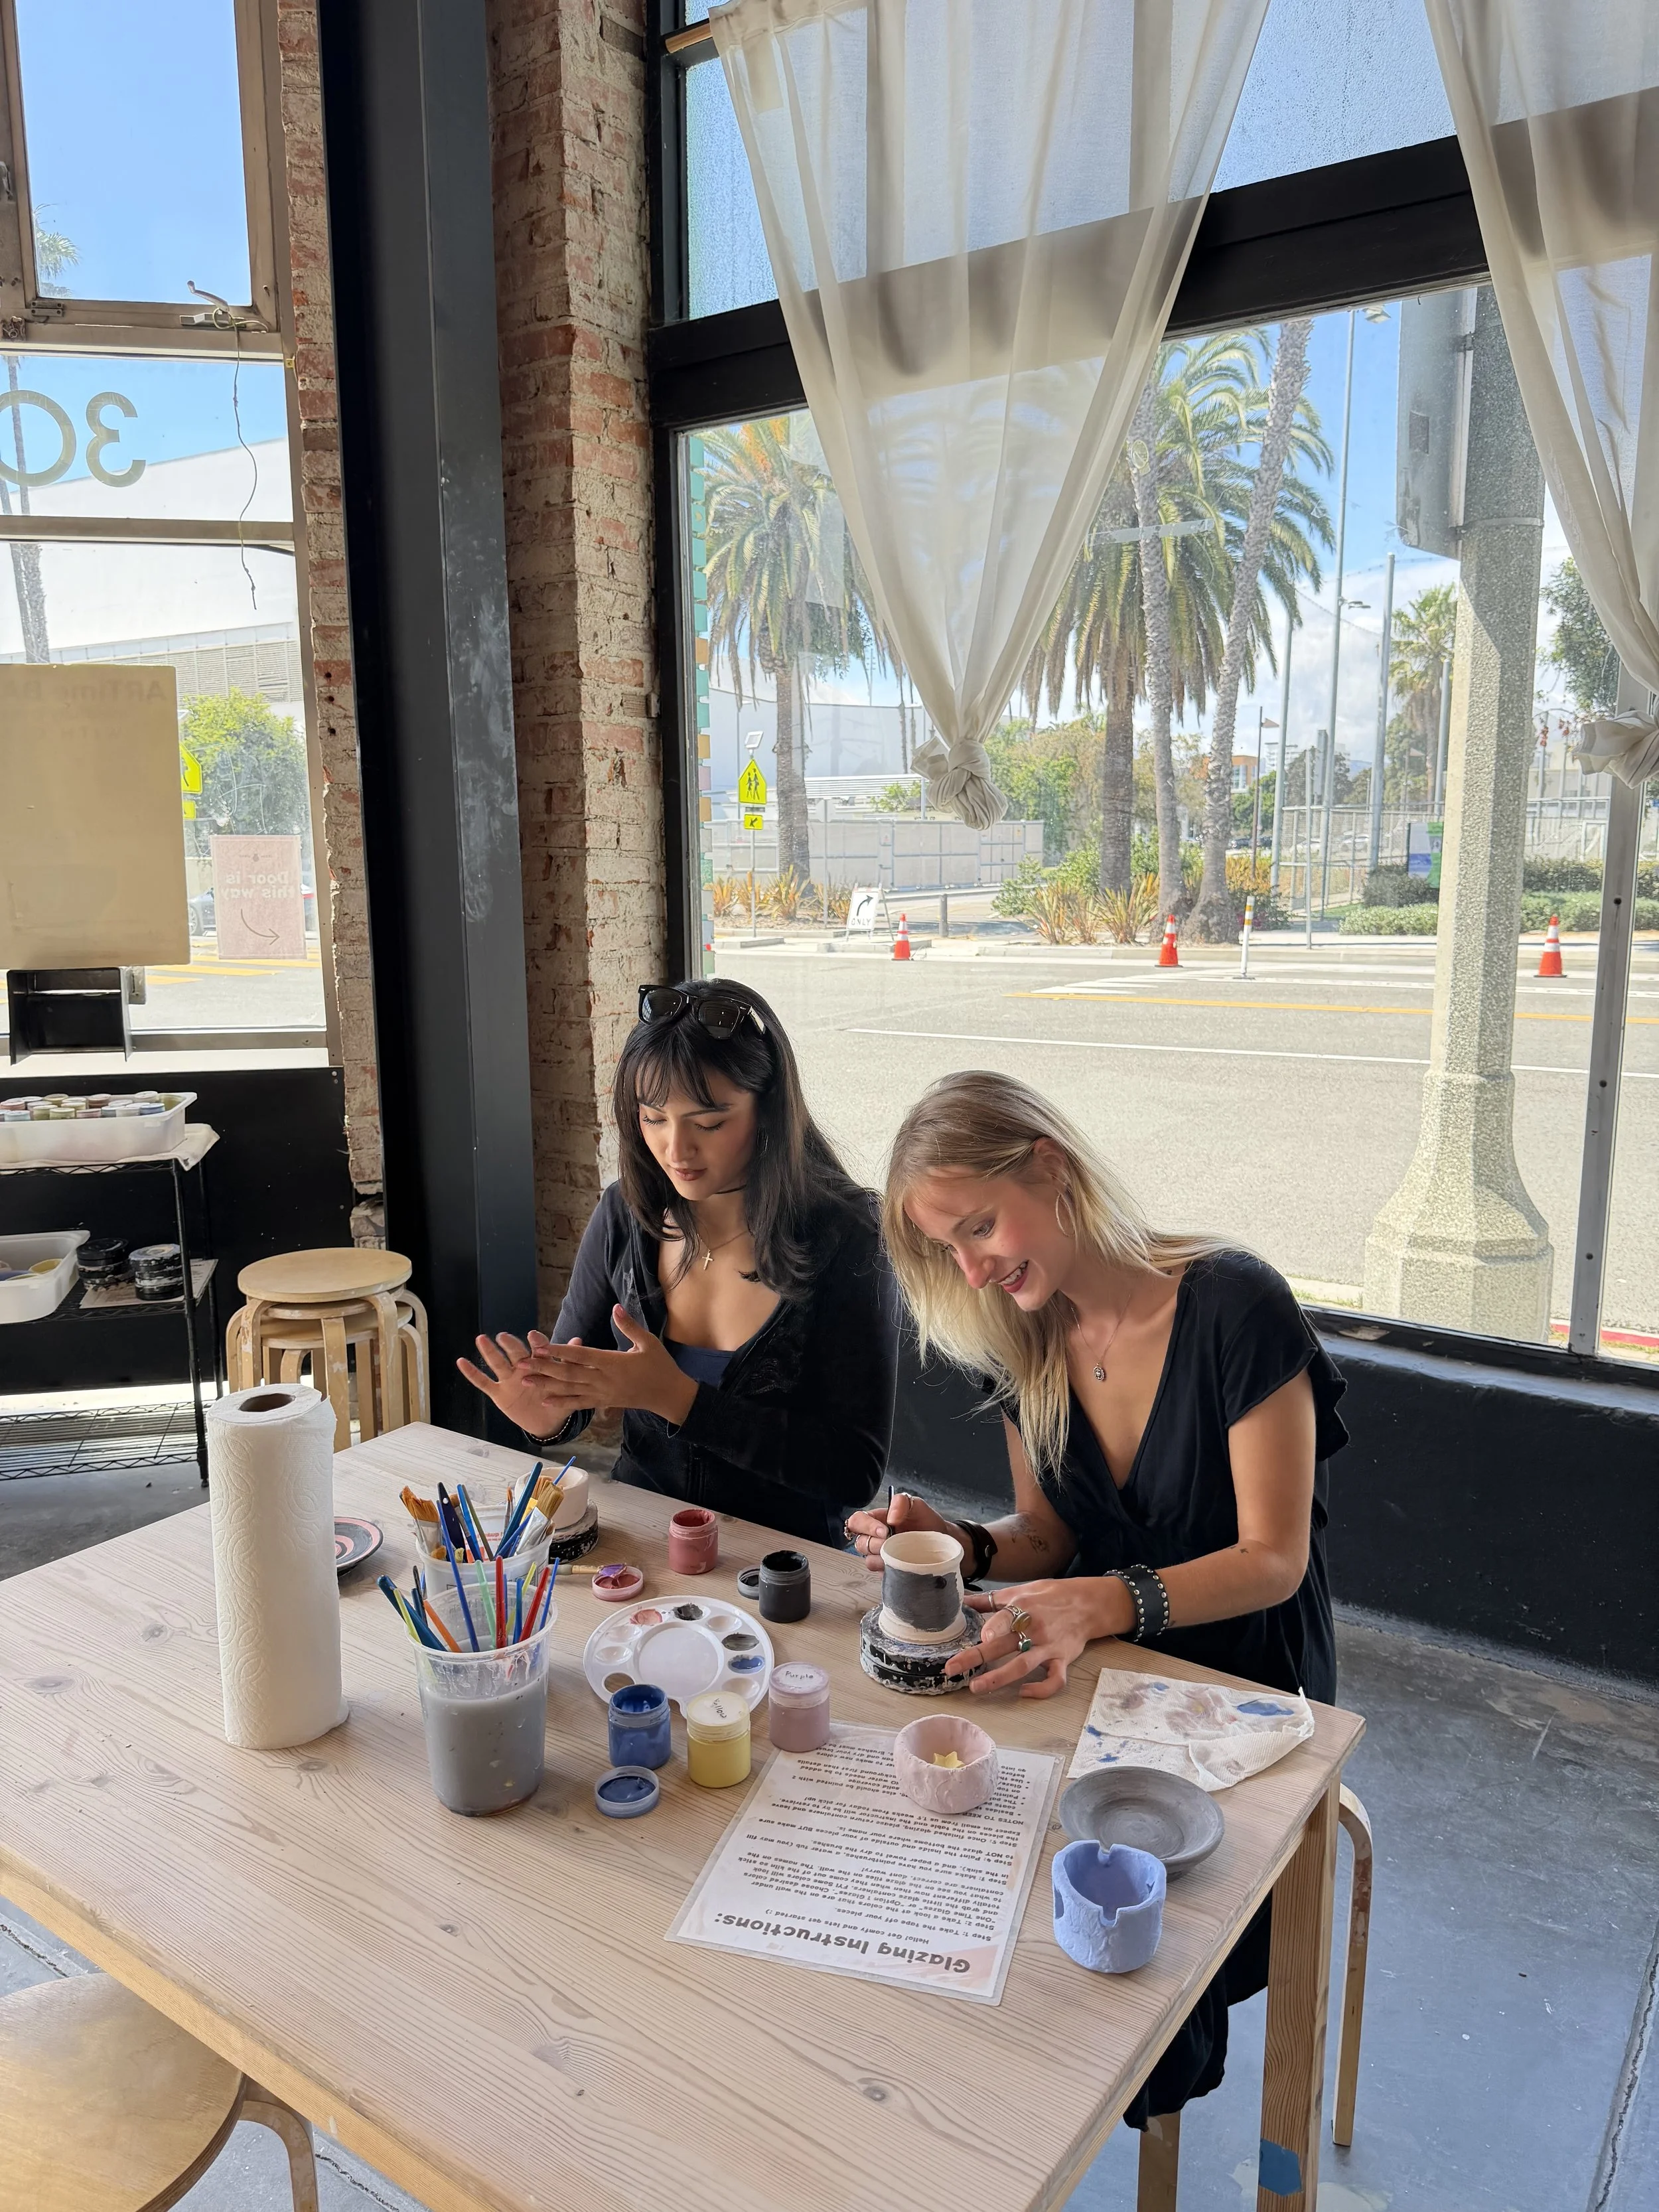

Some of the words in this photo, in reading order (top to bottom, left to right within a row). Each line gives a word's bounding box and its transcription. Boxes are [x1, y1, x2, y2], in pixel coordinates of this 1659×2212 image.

[785, 1670, 814, 1680] Purple
[808, 1809, 847, 1818] containers
[858, 1812, 897, 1822] instructor
[933, 1830, 964, 1839] finished
[812, 1840, 843, 1850] brushes.
[914, 1840, 945, 1848] bottoms
[768, 1877, 799, 1887] desired
[801, 1883, 830, 1893] Choose
[960, 1885, 1003, 1895] containers
[873, 1897, 904, 1907] "Option
[932, 1893, 970, 1904] different
[972, 1900, 999, 1909] totally
[774, 1911, 806, 1920] started
[835, 1907, 863, 1916] pieces.
[918, 1906, 950, 1915] Glazes"
[942, 1916, 961, 1925] Take
[714, 1913, 869, 1954] Instructions:
[904, 1935, 929, 1945] Hello!
[877, 1942, 970, 1973] Glazing
